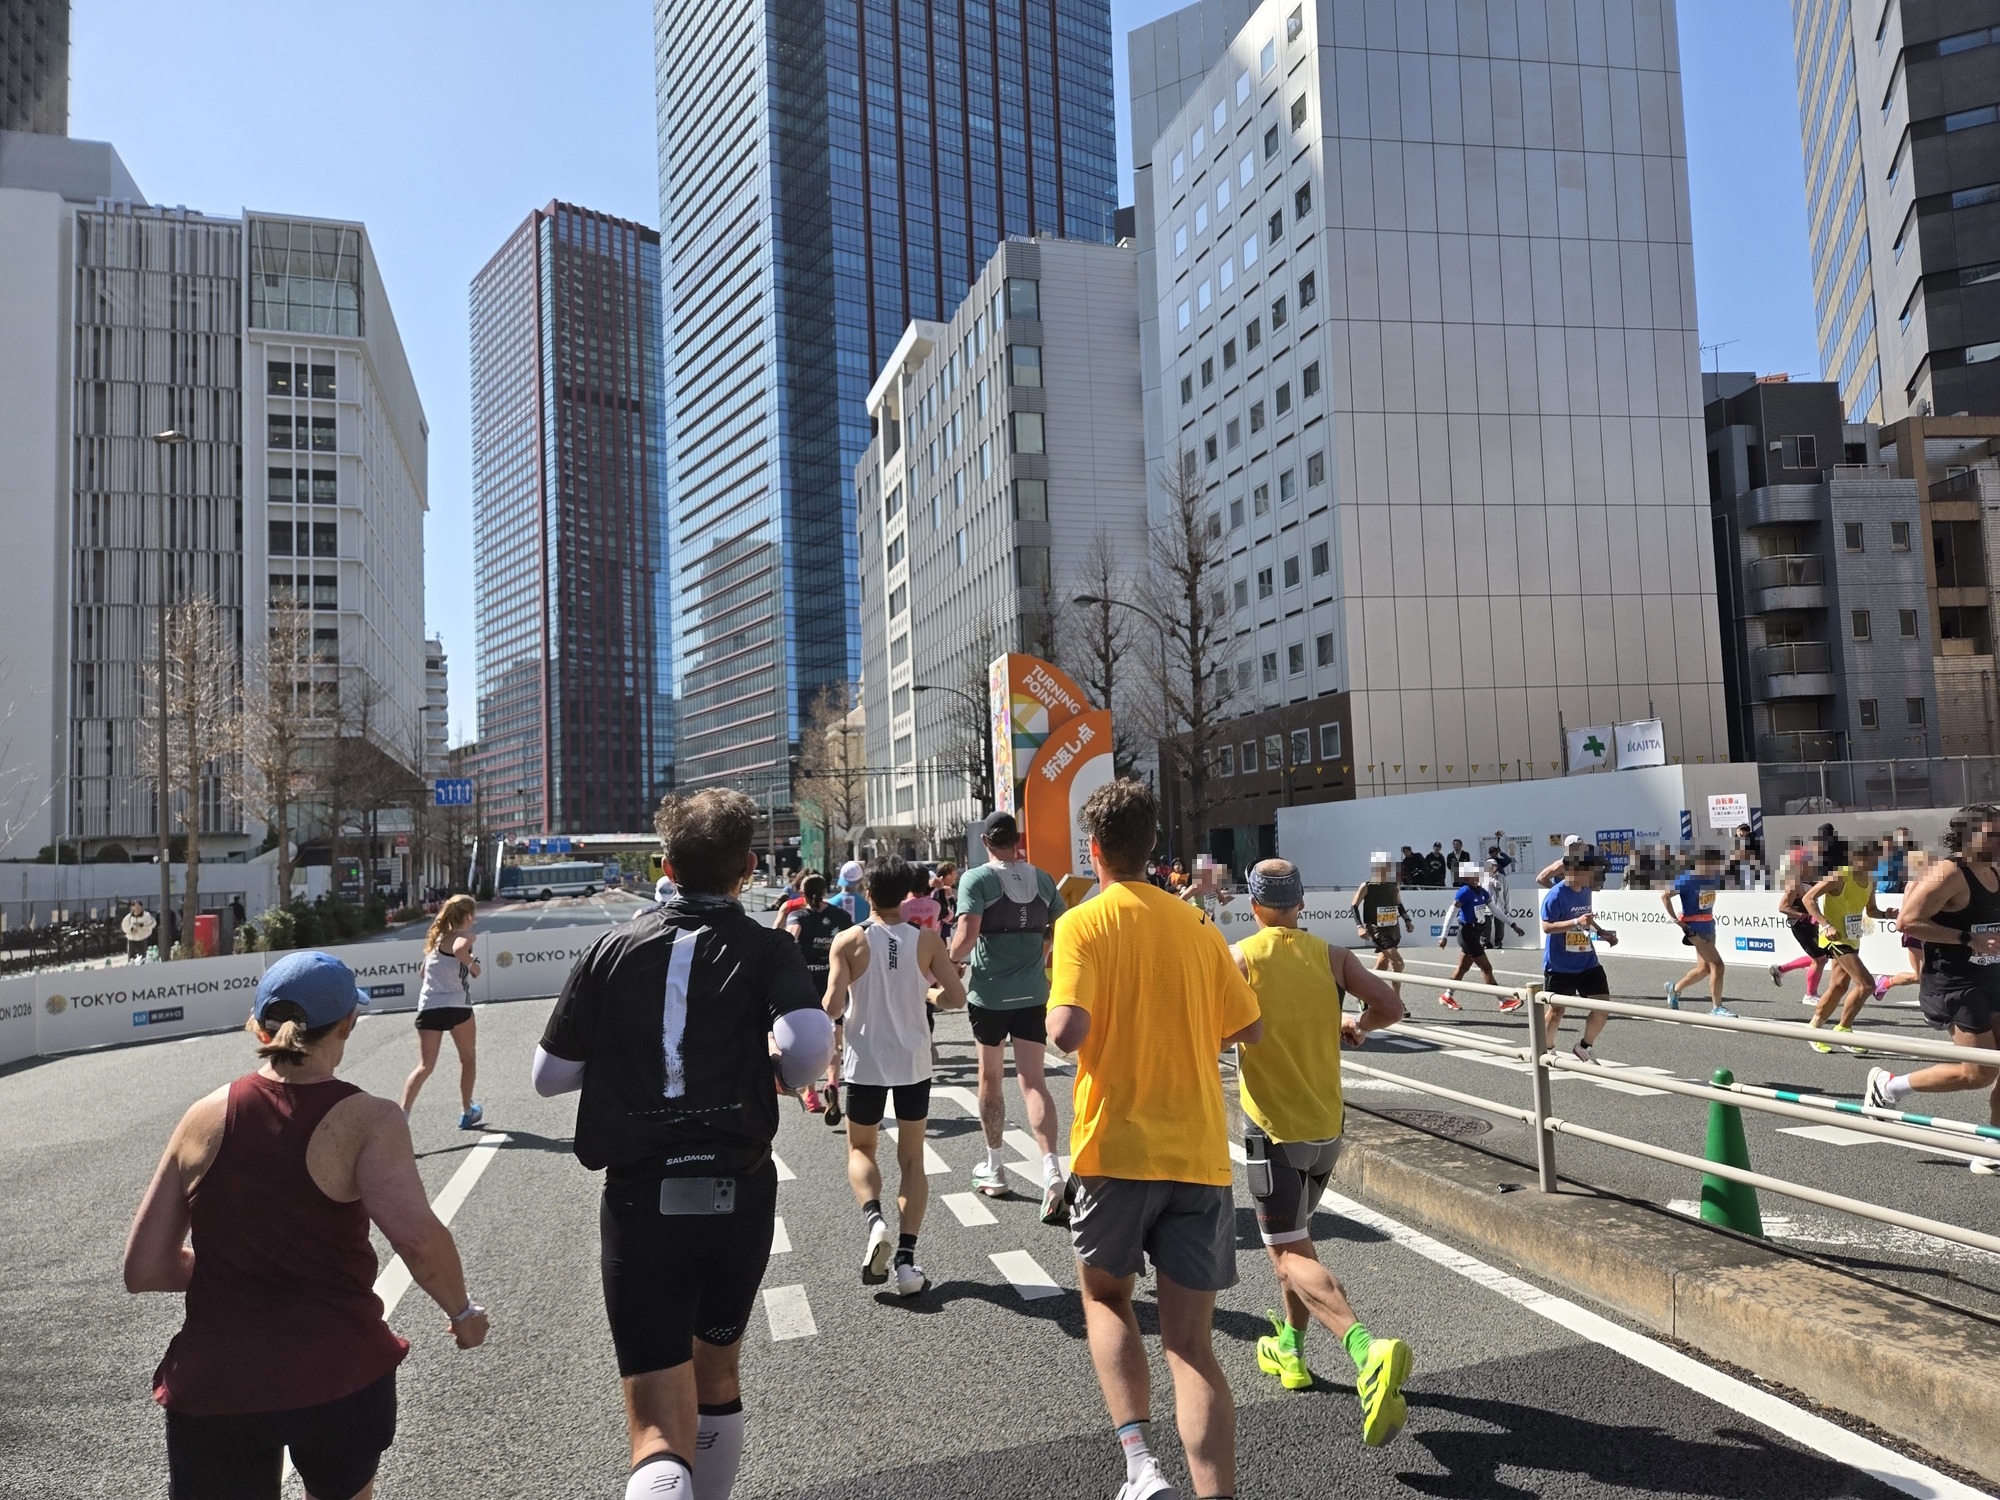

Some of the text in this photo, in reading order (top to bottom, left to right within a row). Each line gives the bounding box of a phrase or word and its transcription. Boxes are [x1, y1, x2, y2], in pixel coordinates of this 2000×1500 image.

[1022, 674, 1059, 710] POINT
[1032, 664, 1082, 715] TURNING
[1041, 722, 1096, 782] 折返し点
[1715, 797, 1739, 805] 自転車は
[1235, 909, 1355, 922] TOK ATHON 202
[1594, 911, 1667, 923] ARATHON 2026
[1734, 916, 1792, 928] MARATHO
[516, 949, 566, 964] TOKYO
[354, 961, 425, 978] MARATH
[70, 975, 259, 1009] TOKYO MARATHON 2026
[13, 1002, 32, 1018] 2026
[665, 1154, 716, 1166] SALOMON
